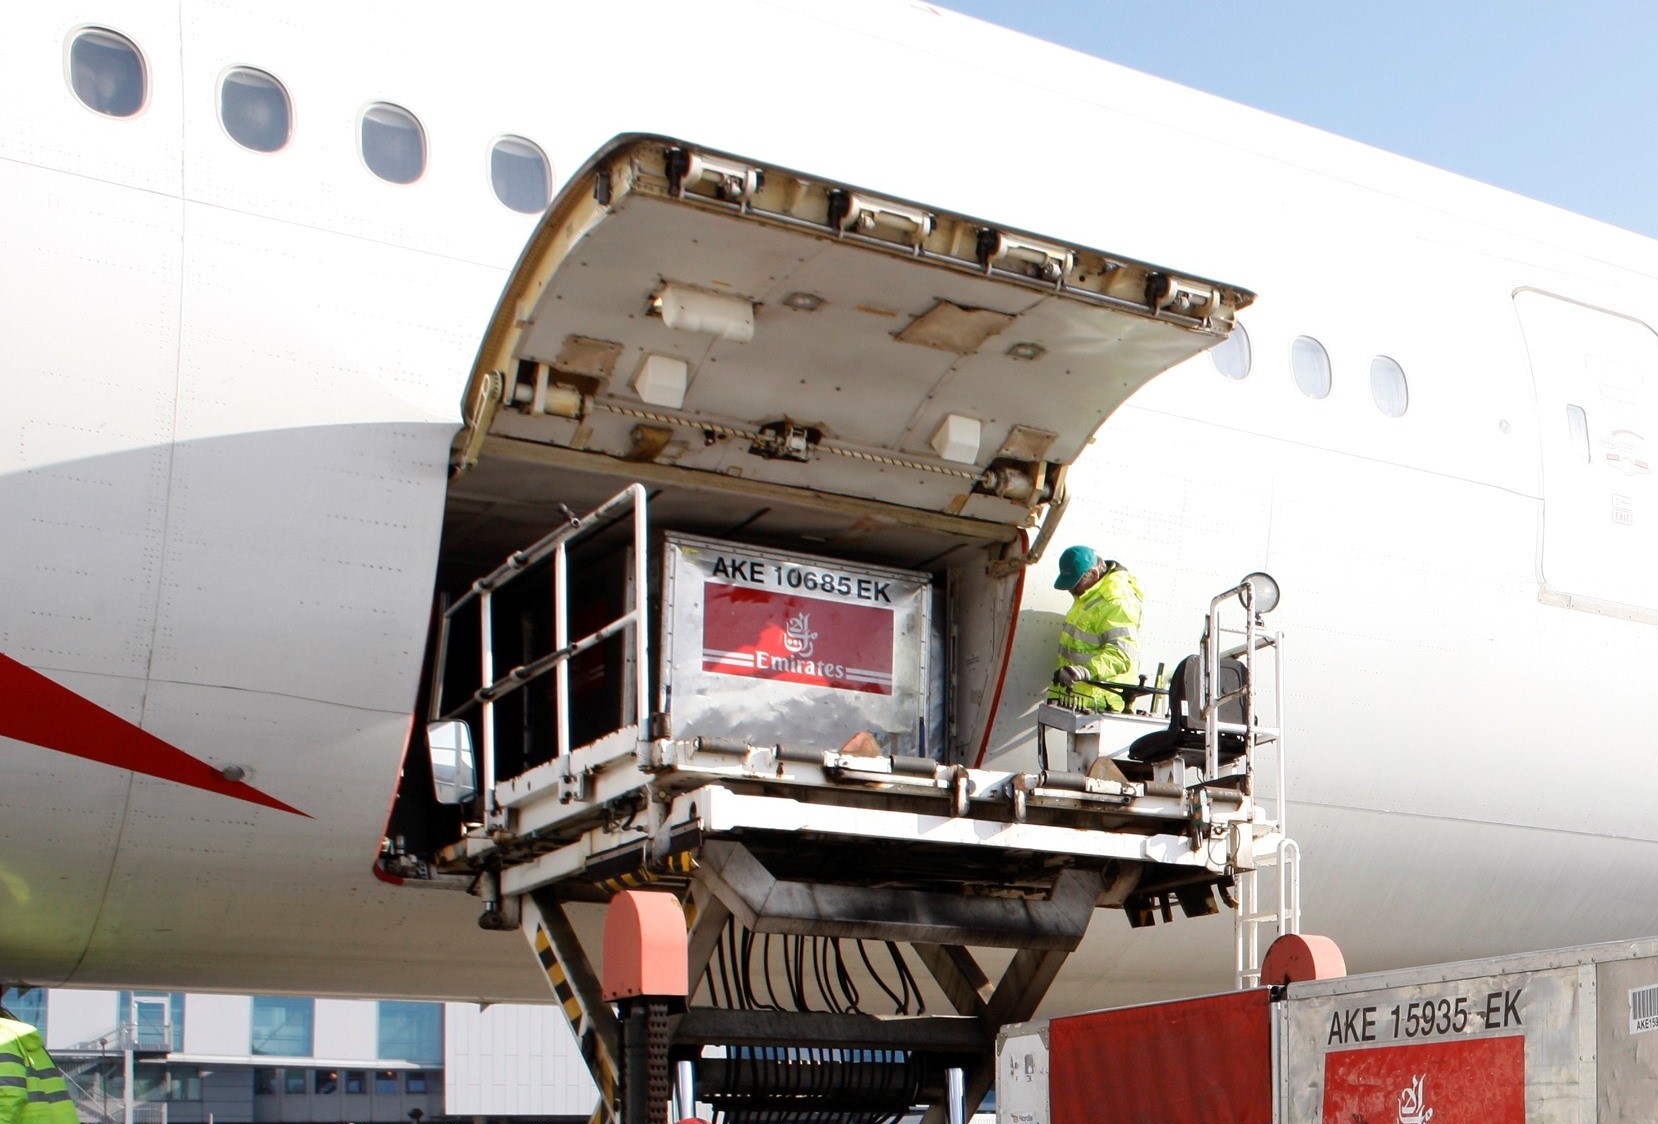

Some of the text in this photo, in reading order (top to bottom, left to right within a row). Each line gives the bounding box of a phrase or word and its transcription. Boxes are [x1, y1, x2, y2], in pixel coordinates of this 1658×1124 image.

[712, 556, 891, 603] AKE 10685 EK
[755, 651, 844, 679] Emirates
[1328, 989, 1523, 1045] AKE 15935 EK
